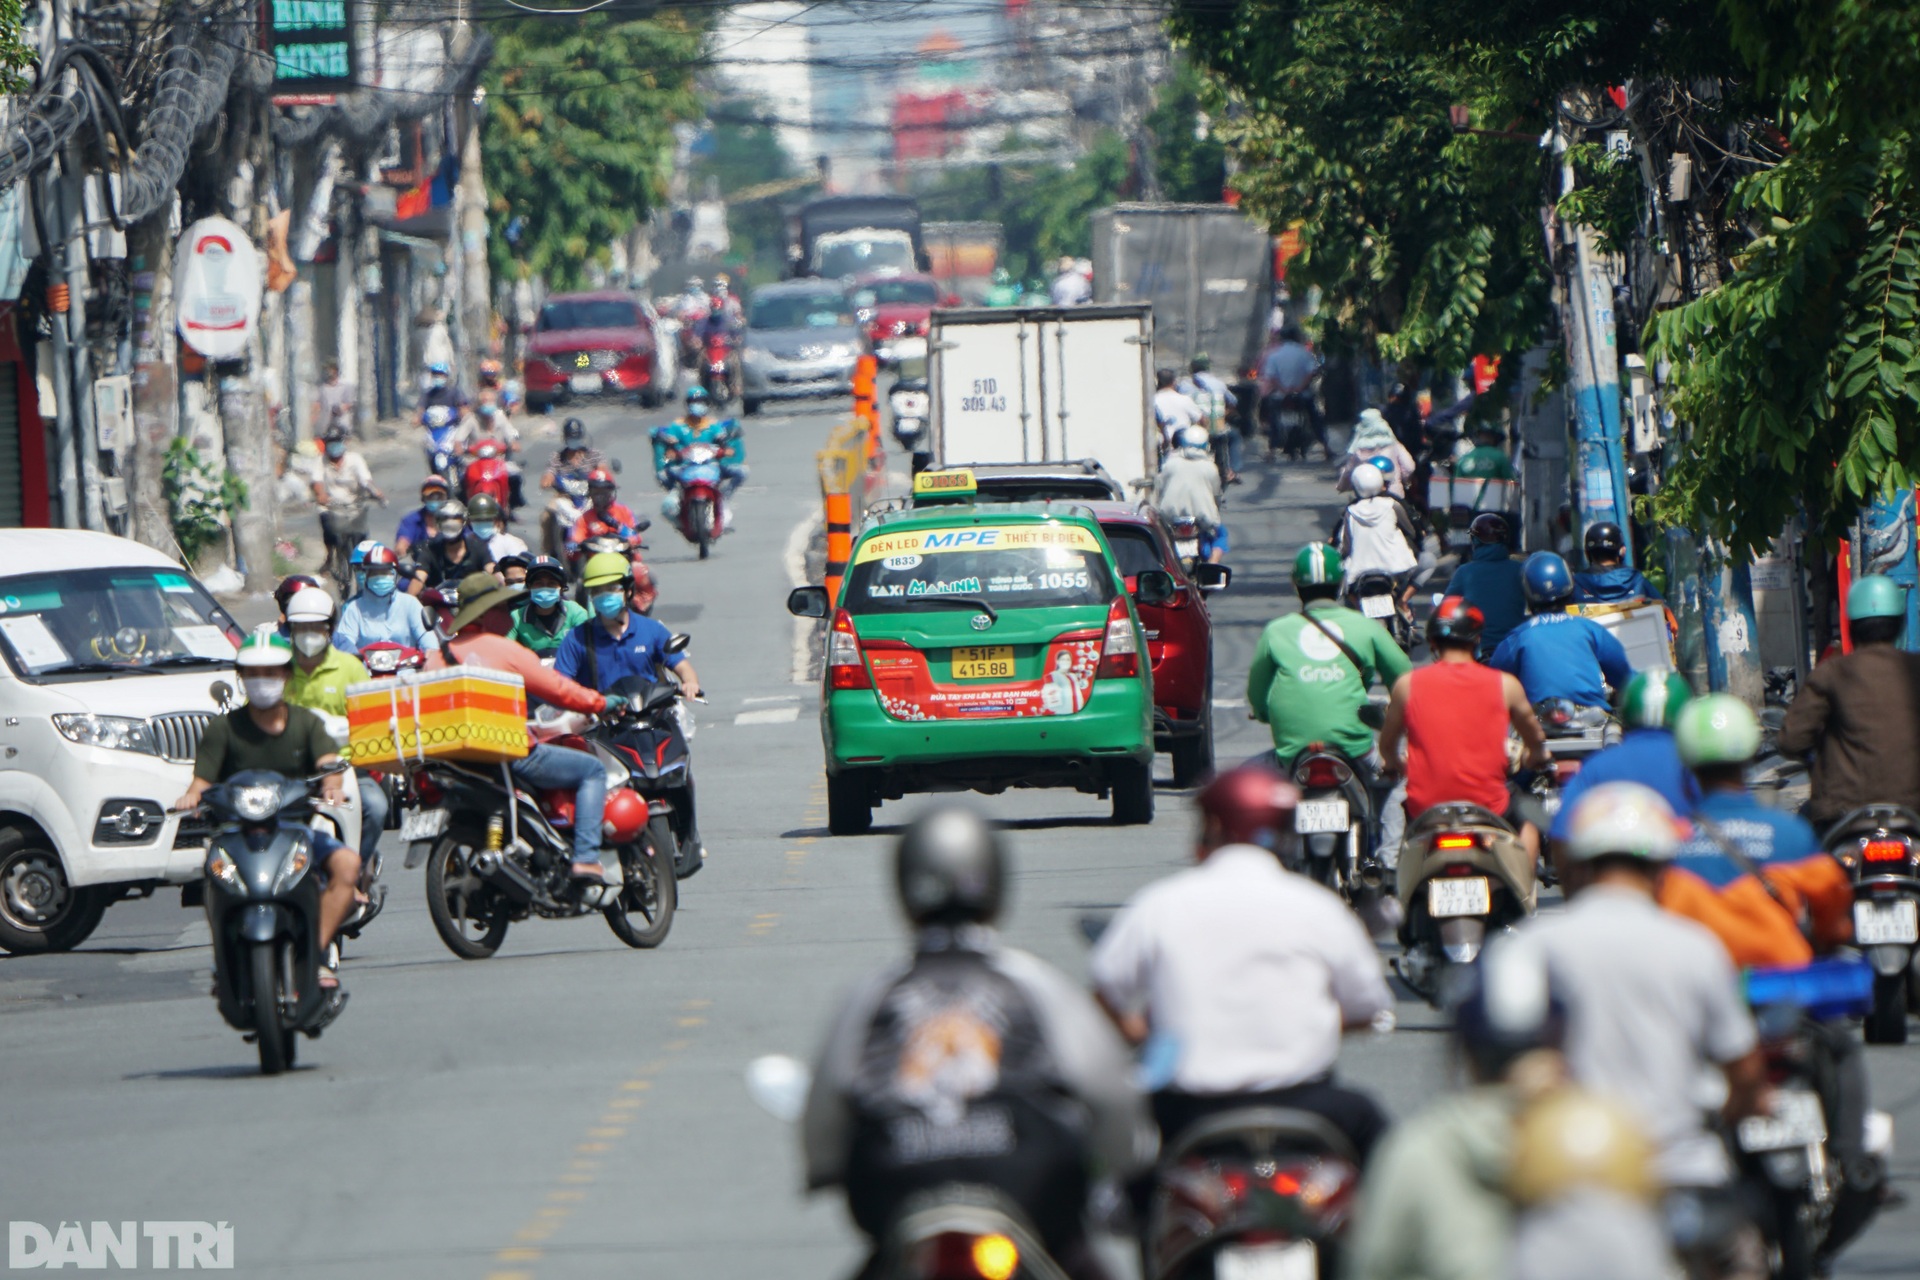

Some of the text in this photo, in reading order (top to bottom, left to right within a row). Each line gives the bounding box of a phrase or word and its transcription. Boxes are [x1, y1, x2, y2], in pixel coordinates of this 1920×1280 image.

[974, 378, 997, 395] 51D
[870, 540, 893, 554] ĐÈN
[897, 538, 919, 550] LED
[924, 530, 999, 549] MPE
[1005, 529, 1037, 543] THIẾT
[890, 556, 915, 567] 1833
[1038, 571, 1088, 589] 1055
[969, 648, 996, 661] 51F
[959, 662, 1008, 677] 415.88
[1299, 664, 1346, 683] Grab
[948, 693, 963, 701] TAY
